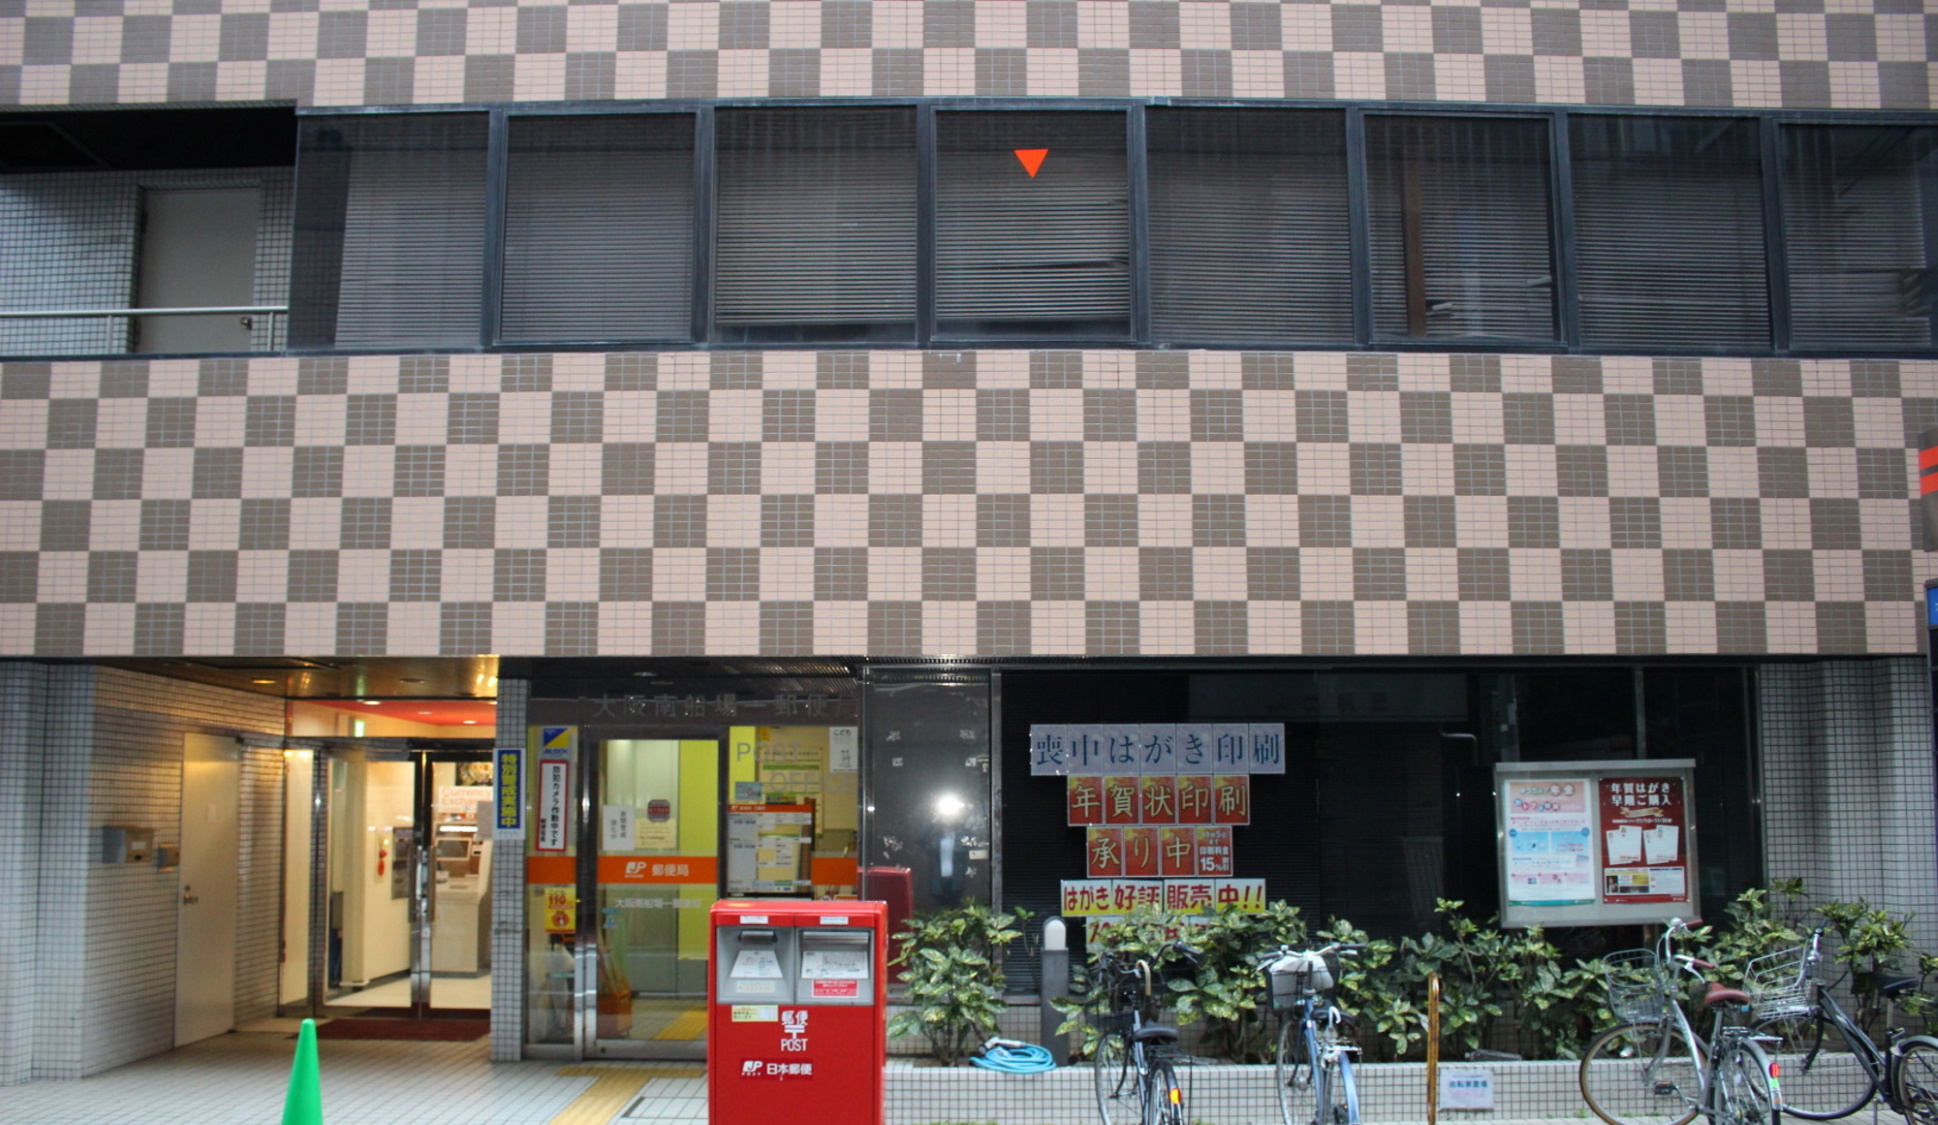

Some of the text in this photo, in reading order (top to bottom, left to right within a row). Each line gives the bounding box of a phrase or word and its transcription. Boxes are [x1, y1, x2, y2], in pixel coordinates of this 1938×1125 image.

[1036, 733, 1280, 766] 喪中はがき印刷
[1611, 782, 1670, 793] 年賀はがき
[1071, 784, 1246, 818] 年賀状印刷
[1612, 794, 1671, 806] 早期ご購入
[1091, 836, 1192, 869] 承り中
[652, 864, 689, 876] 郵便局
[781, 1010, 809, 1026] 郵便
[781, 1038, 808, 1051] POST
[767, 1063, 813, 1075] 日本郵便
